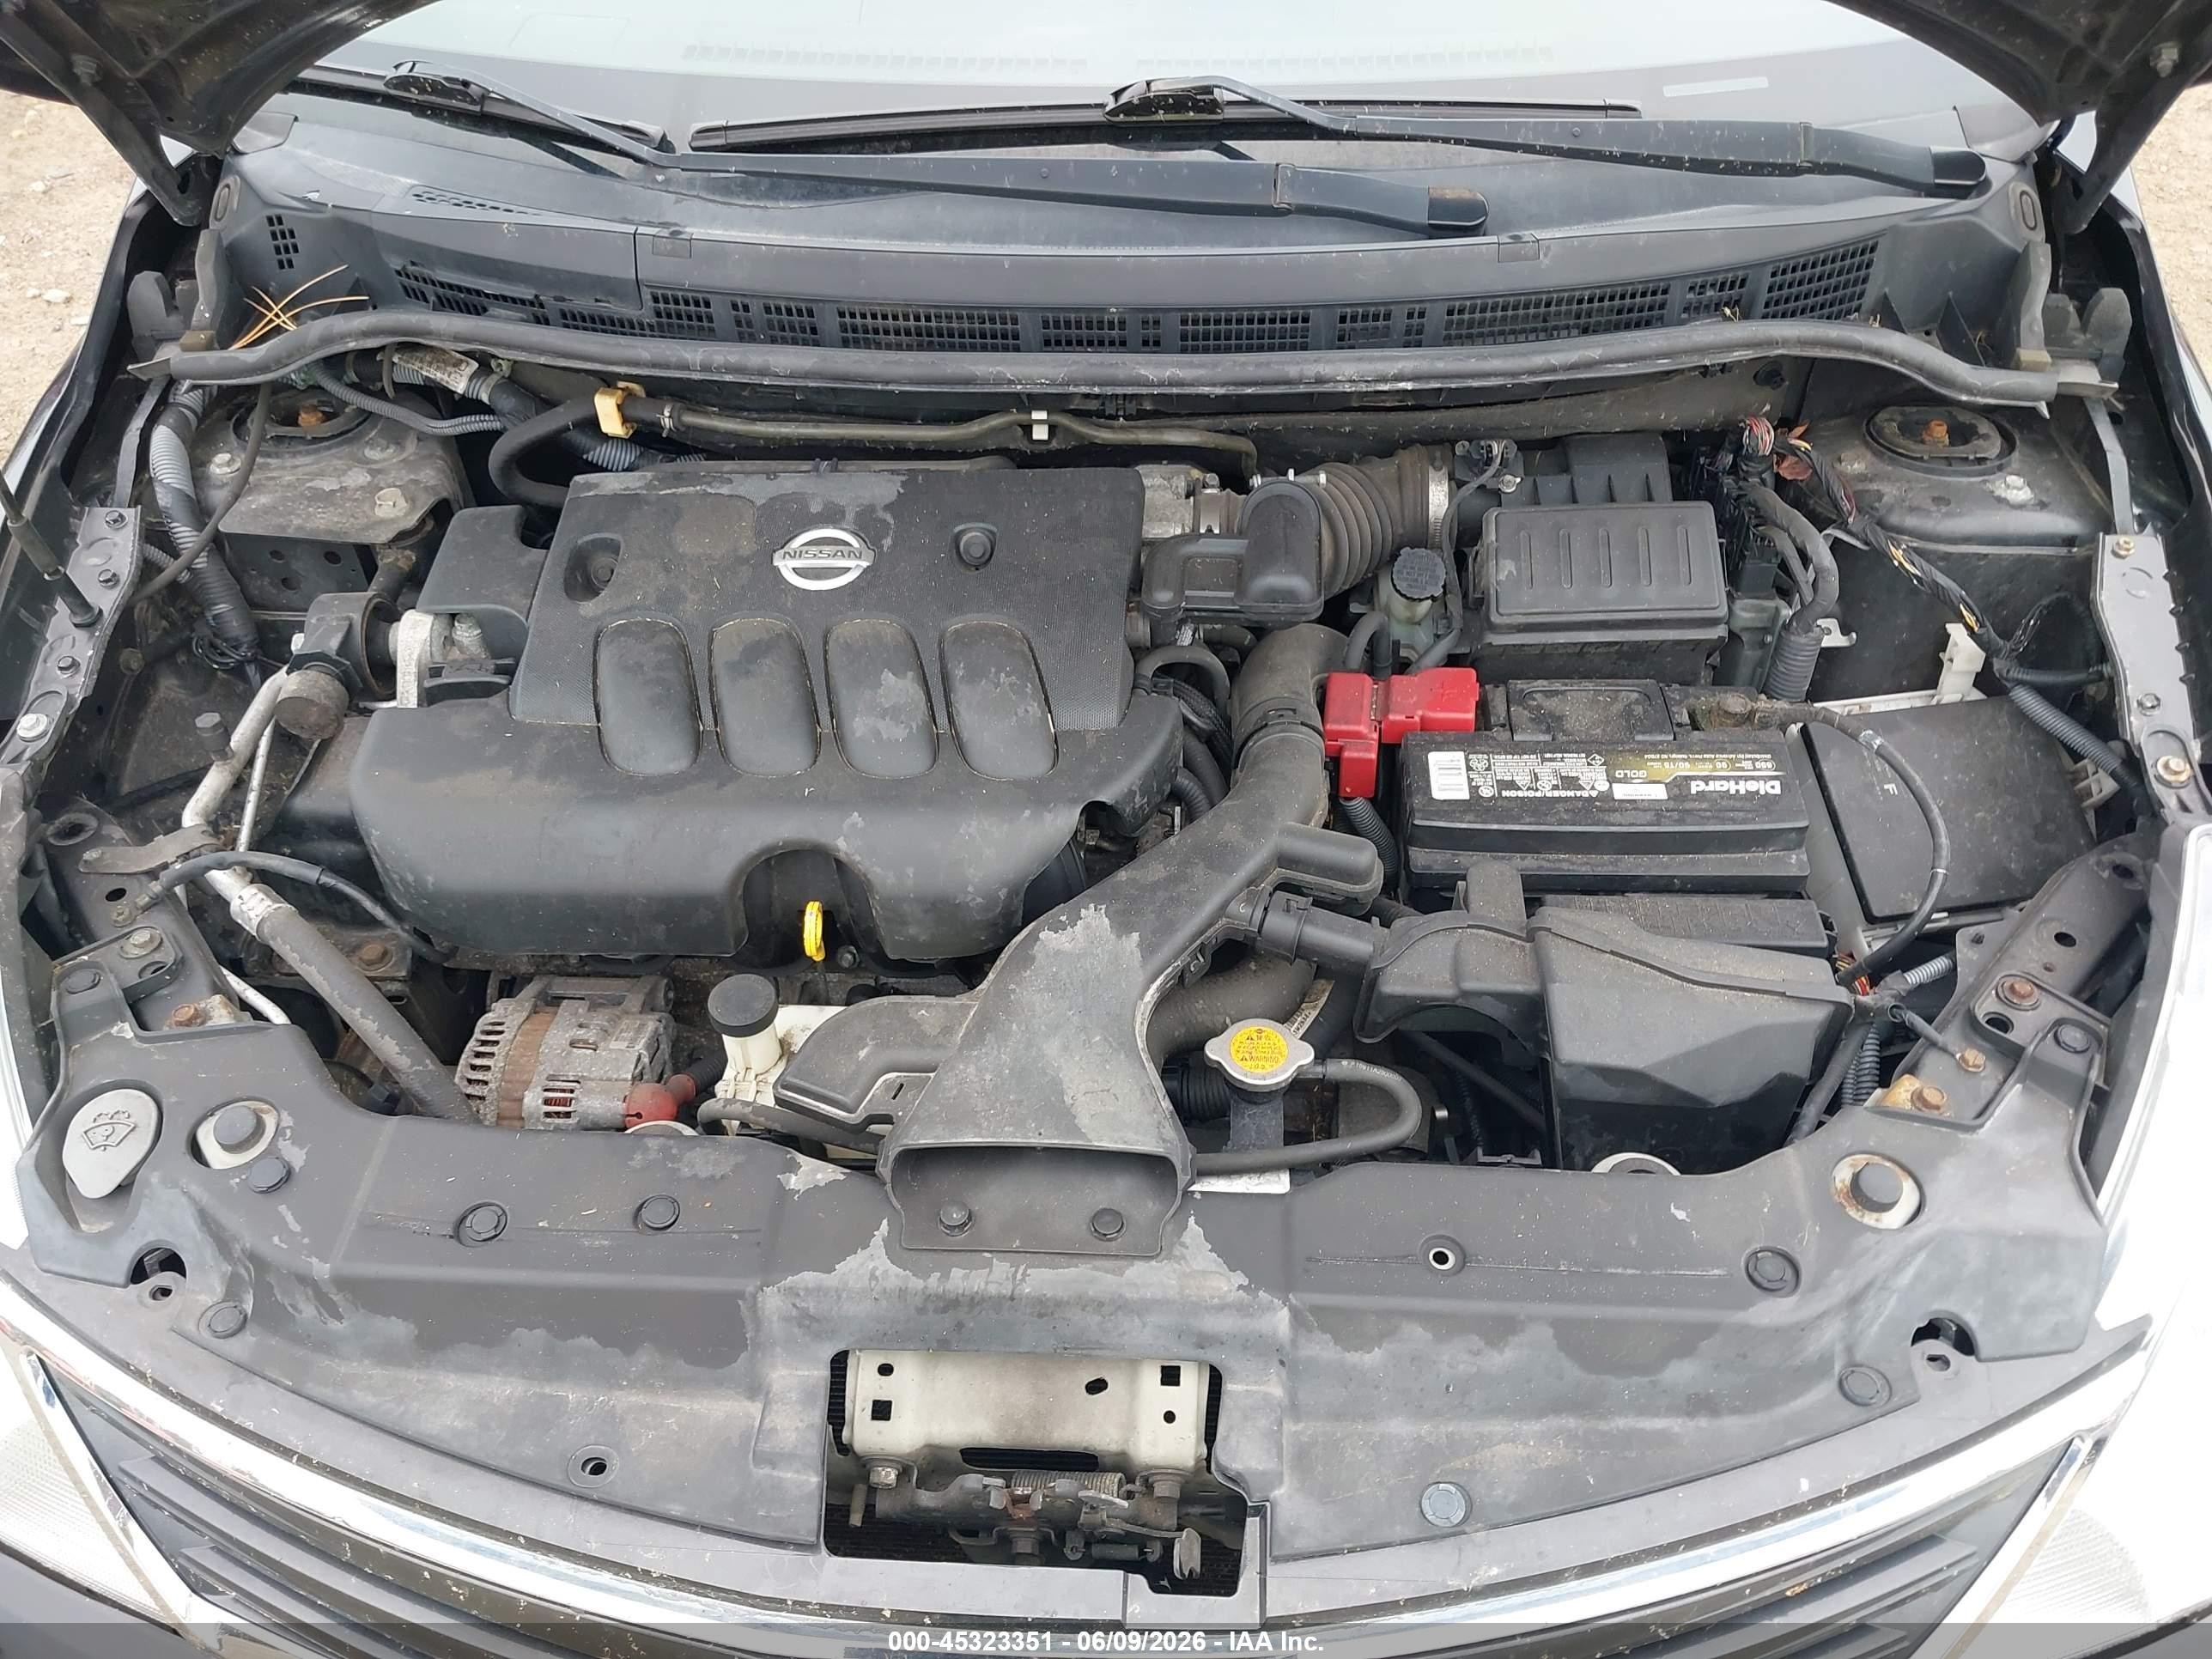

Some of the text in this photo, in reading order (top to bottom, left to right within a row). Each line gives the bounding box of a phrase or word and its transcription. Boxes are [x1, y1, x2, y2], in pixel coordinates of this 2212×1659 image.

[782, 550, 863, 560] NISSAN
[1615, 769, 1647, 778] GOLD
[1690, 780, 1782, 795] DieHard
[1249, 1055, 1279, 1064] WARNING
